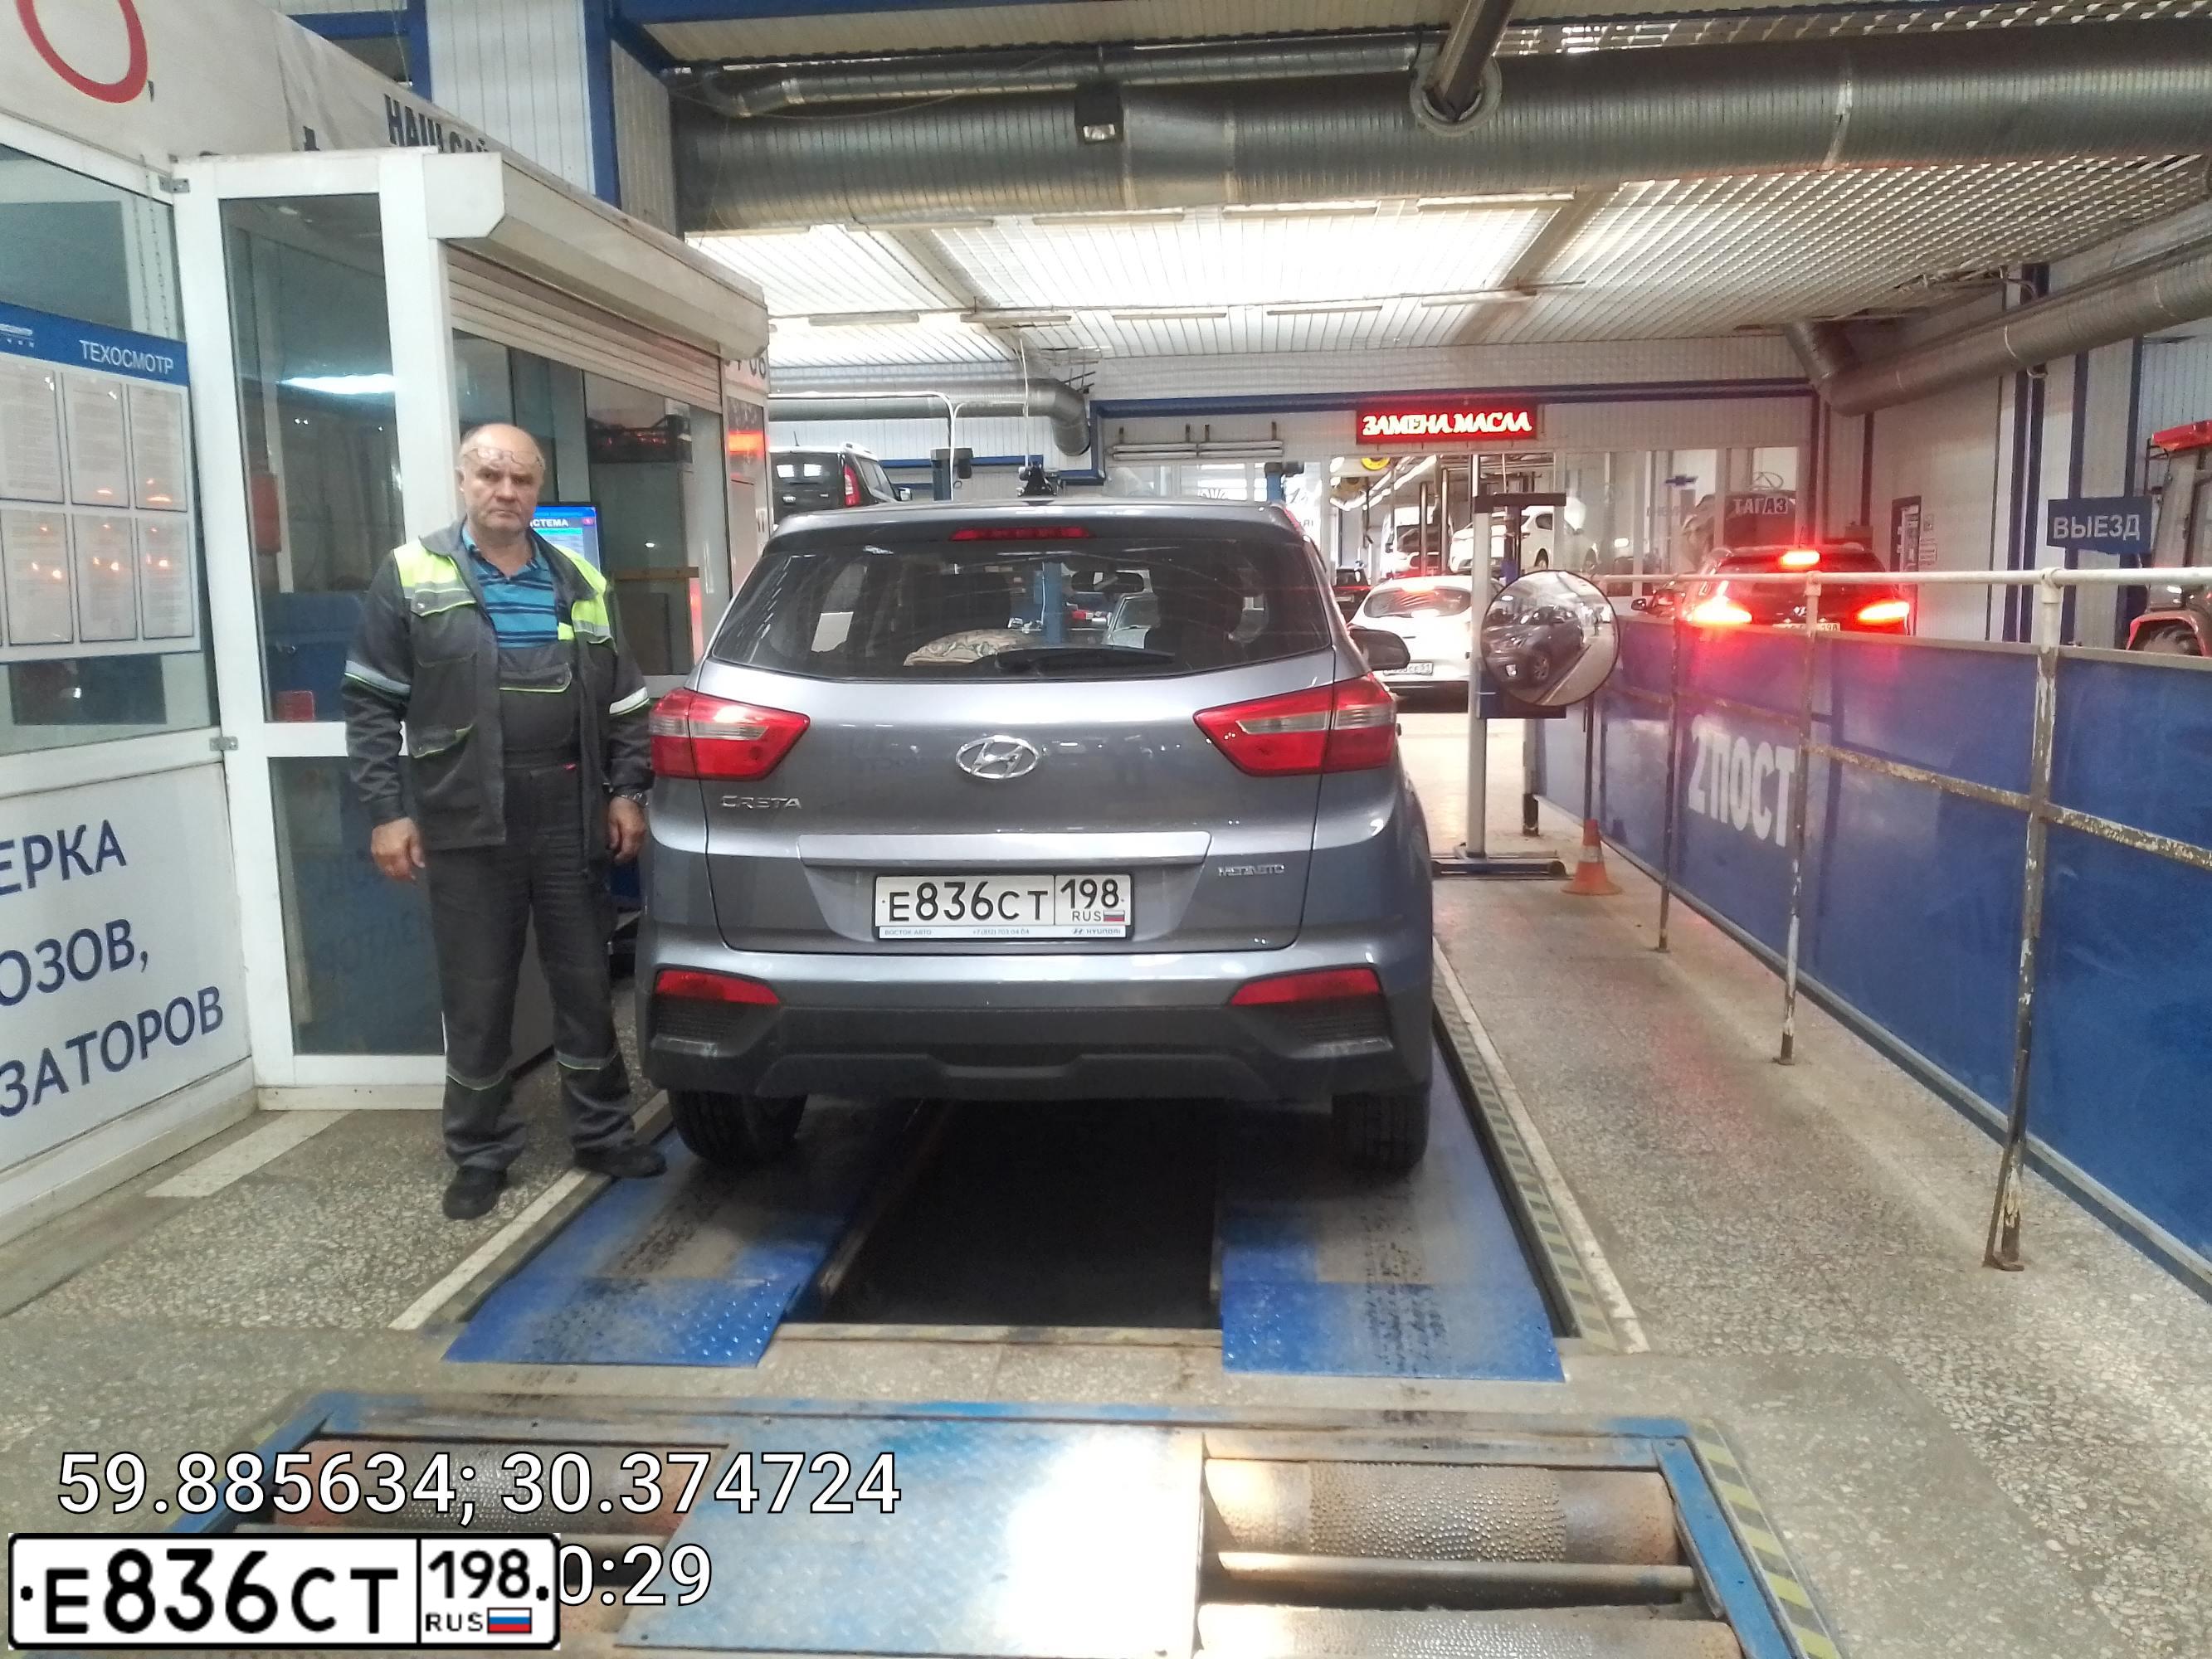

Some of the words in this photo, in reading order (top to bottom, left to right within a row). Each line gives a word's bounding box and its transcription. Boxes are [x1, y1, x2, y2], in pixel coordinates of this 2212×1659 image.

[79, 339, 174, 373] ТЕХОСМОТР
[1362, 414, 1453, 435] ЗАМЕНА
[1454, 411, 1533, 433] МАСЛА
[1732, 497, 1788, 515] ТАГАЗ
[529, 518, 569, 528] СТЕМА
[2053, 513, 2141, 541] ВЫЕЗД
[721, 795, 802, 810] CRETA
[1060, 878, 1120, 909] 198
[1072, 911, 1102, 922] RUS
[0, 918, 148, 1006] ОЗОВ,
[0, 986, 223, 1117] ЗАТОРОВ
